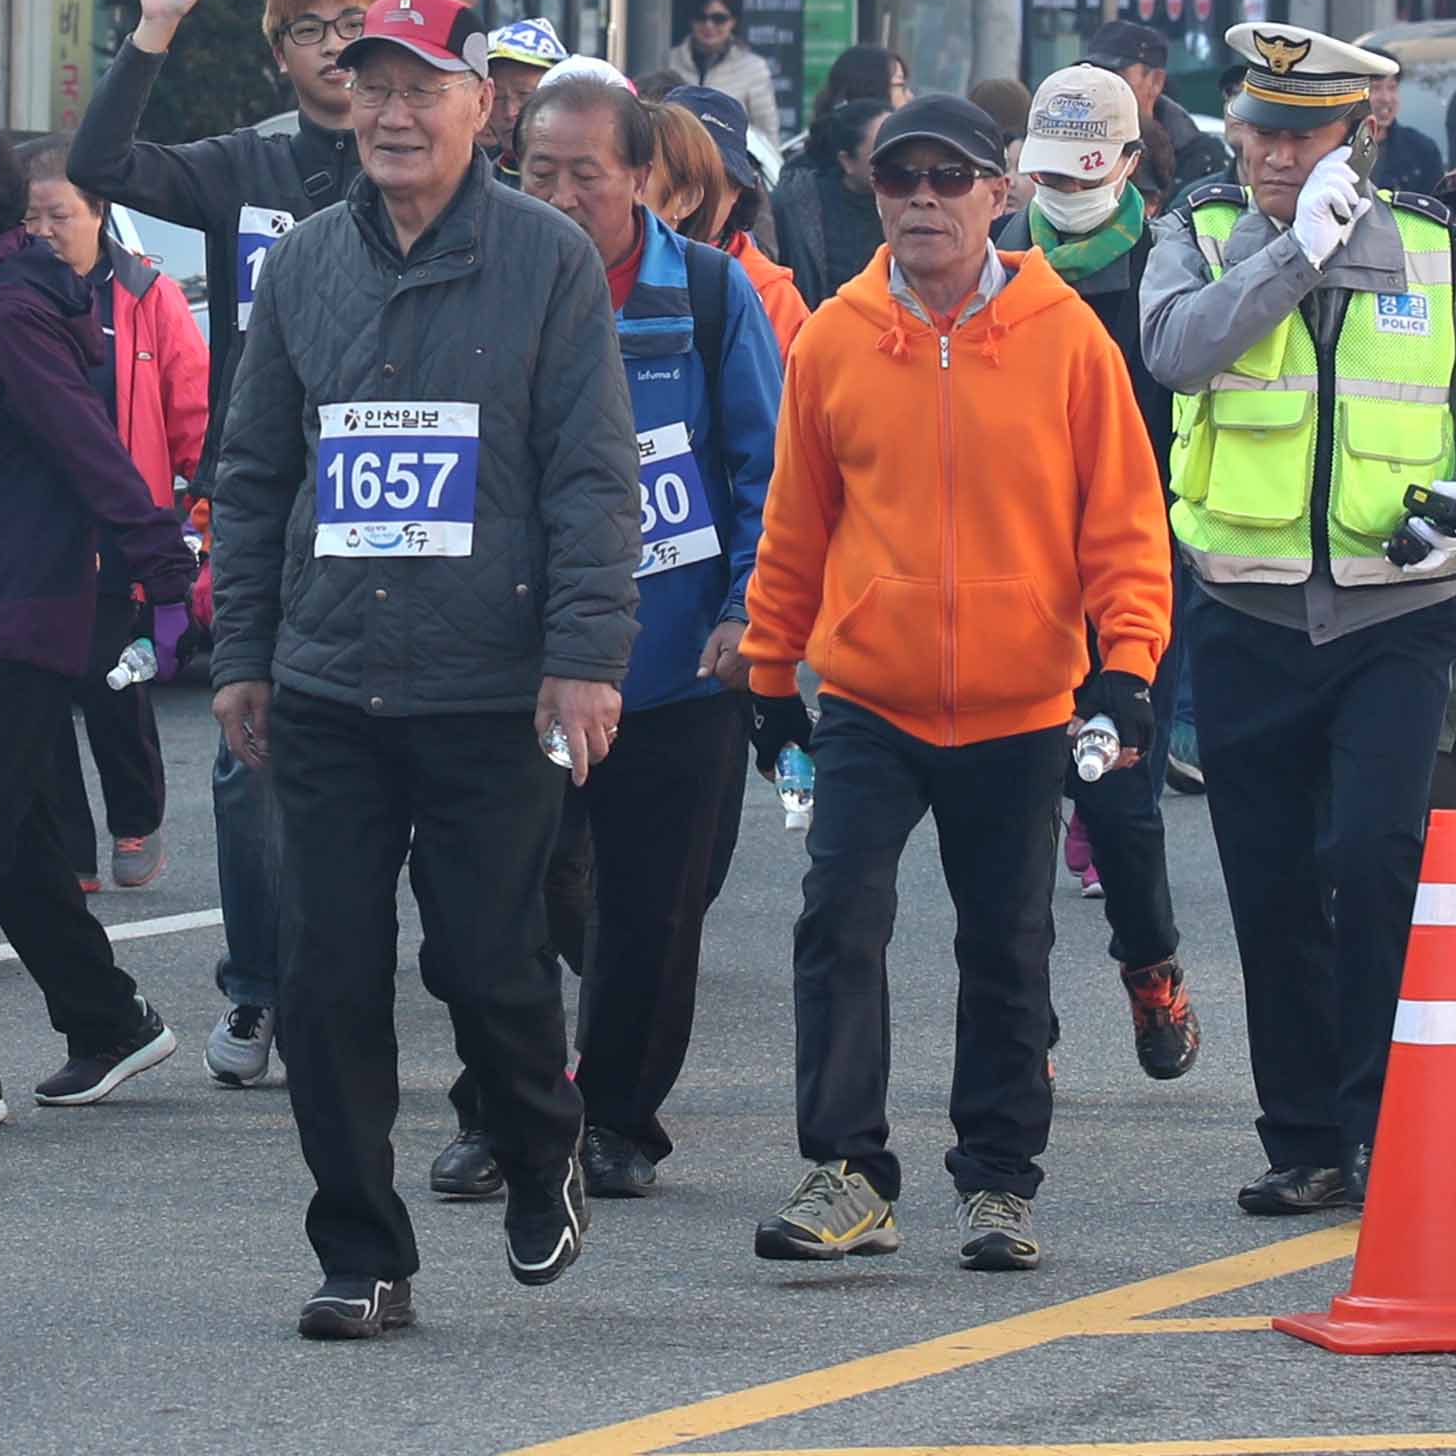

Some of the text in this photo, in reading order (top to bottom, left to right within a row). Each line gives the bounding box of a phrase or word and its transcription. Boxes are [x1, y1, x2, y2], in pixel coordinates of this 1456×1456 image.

[1080, 151, 1104, 171] 22
[1380, 295, 1424, 317] 경찰
[1382, 319, 1425, 331] POLICE
[364, 409, 439, 429] 인천일보
[327, 452, 459, 510] 1657
